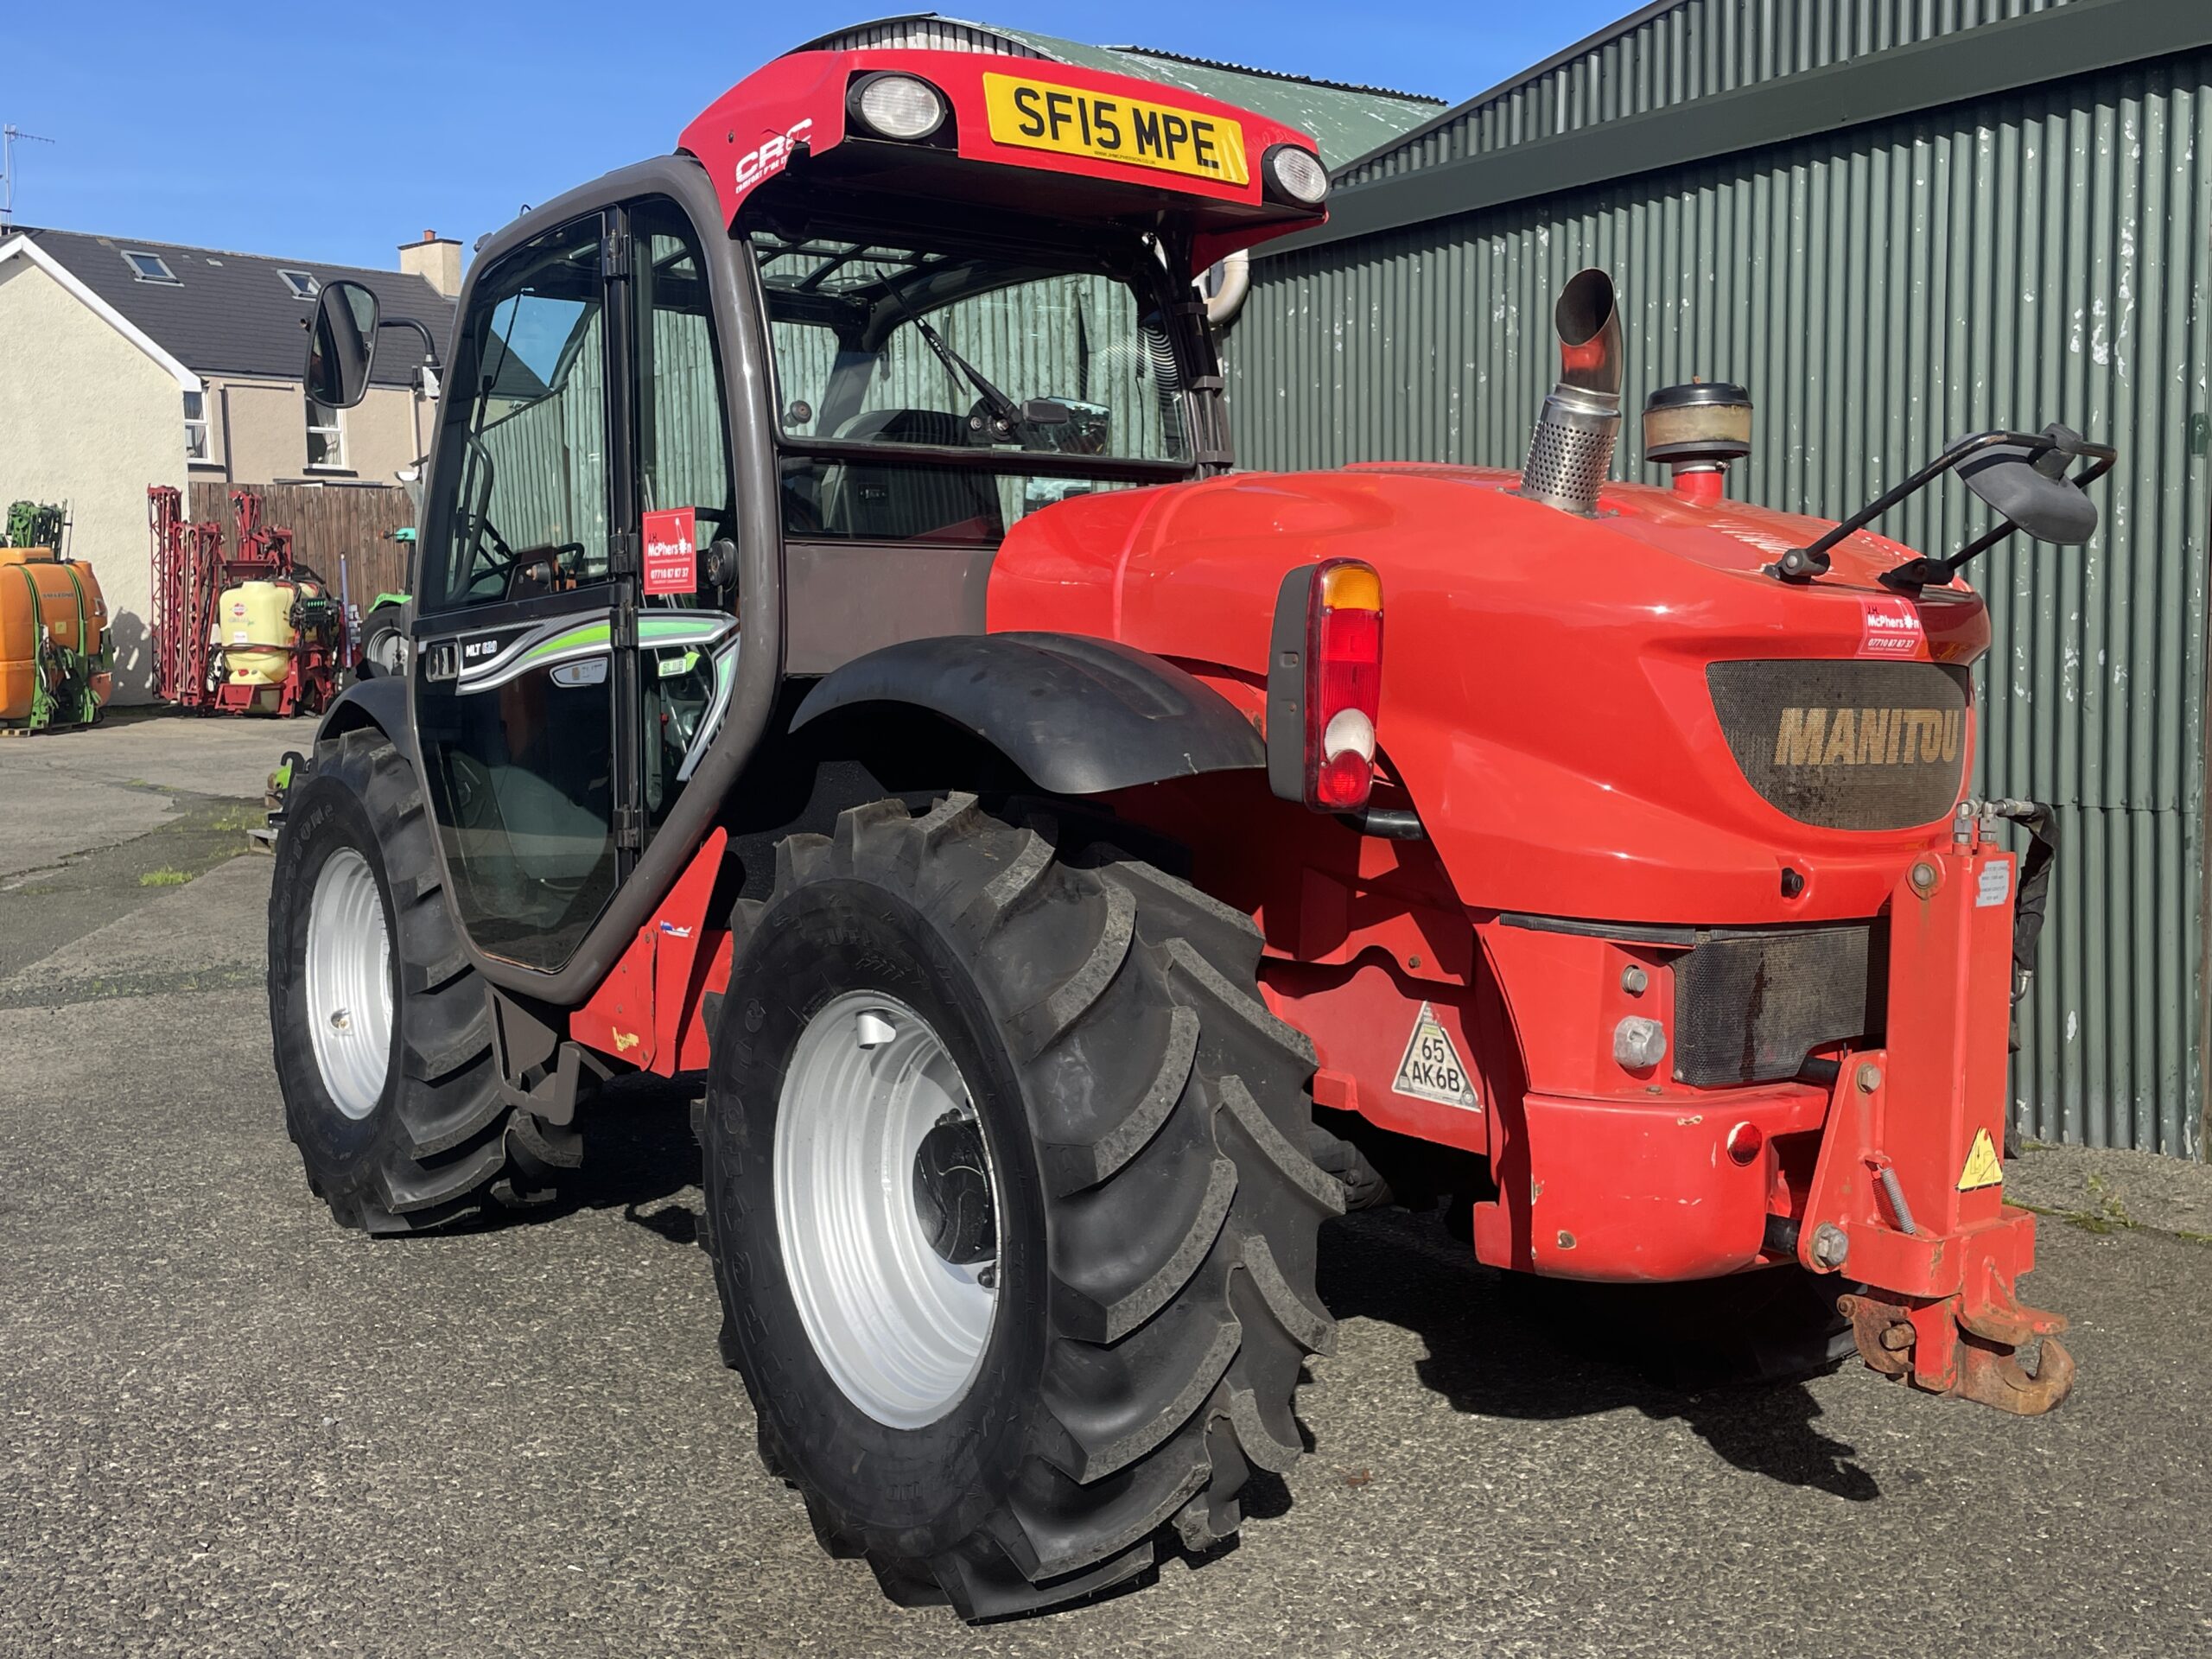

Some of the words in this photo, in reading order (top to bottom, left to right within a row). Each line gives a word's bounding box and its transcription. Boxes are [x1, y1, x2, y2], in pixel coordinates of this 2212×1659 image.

[735, 118, 812, 183] CRC
[1014, 86, 1122, 151] SF15
[1132, 107, 1220, 169] MPE
[466, 643, 481, 657] MLT
[1774, 707, 1960, 766] MANITOU
[1421, 1036, 1445, 1064] 65
[1412, 1060, 1460, 1093] AK6B
